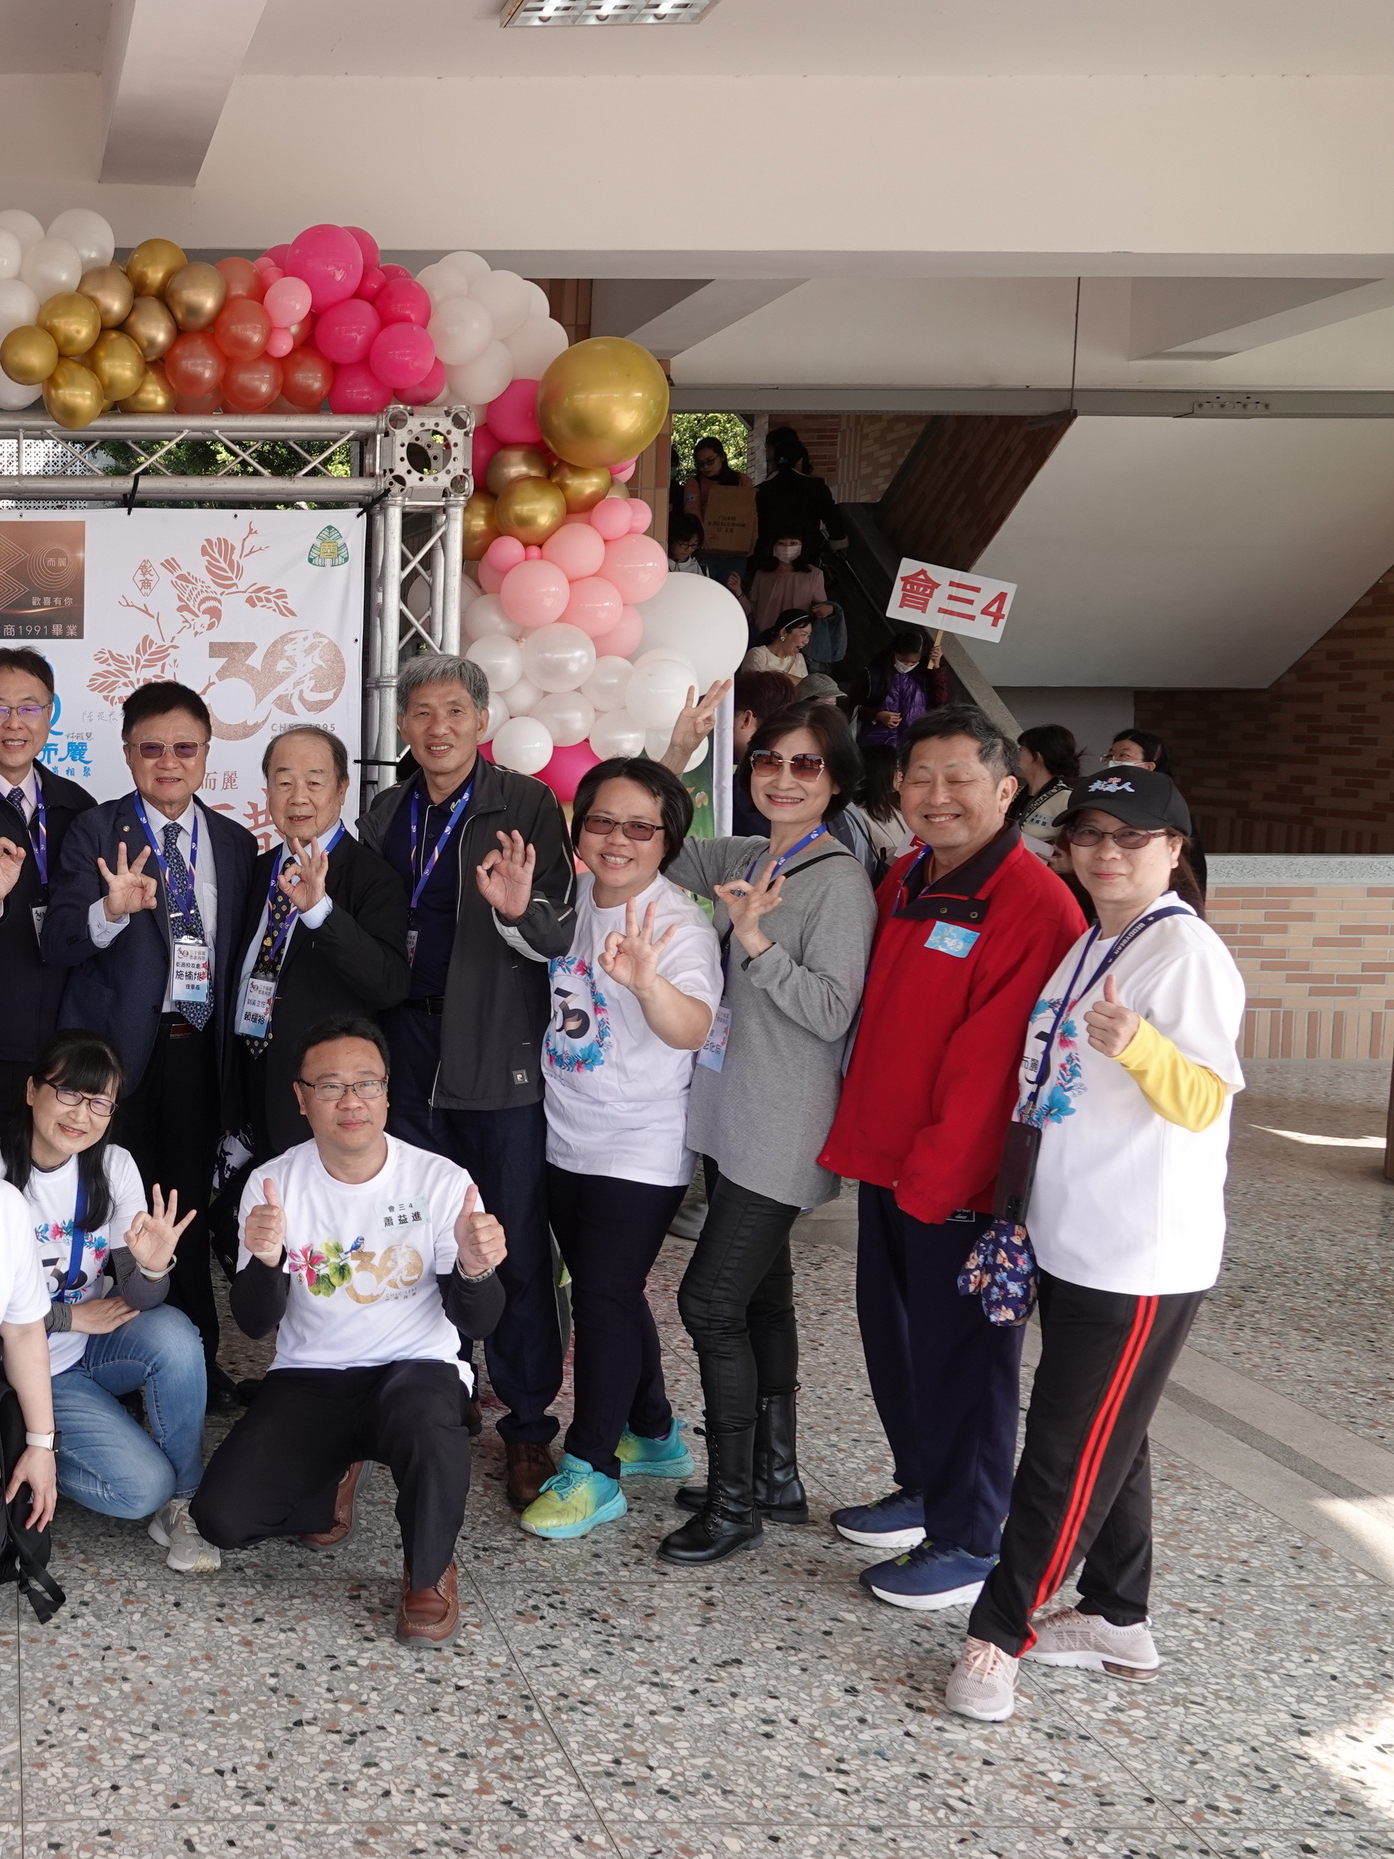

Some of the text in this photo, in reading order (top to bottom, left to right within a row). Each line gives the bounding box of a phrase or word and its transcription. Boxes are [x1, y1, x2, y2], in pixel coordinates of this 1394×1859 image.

[31, 596, 74, 607] 歡喜有你
[899, 567, 1009, 628] 會三4
[383, 1210, 423, 1228] 蕭益進
